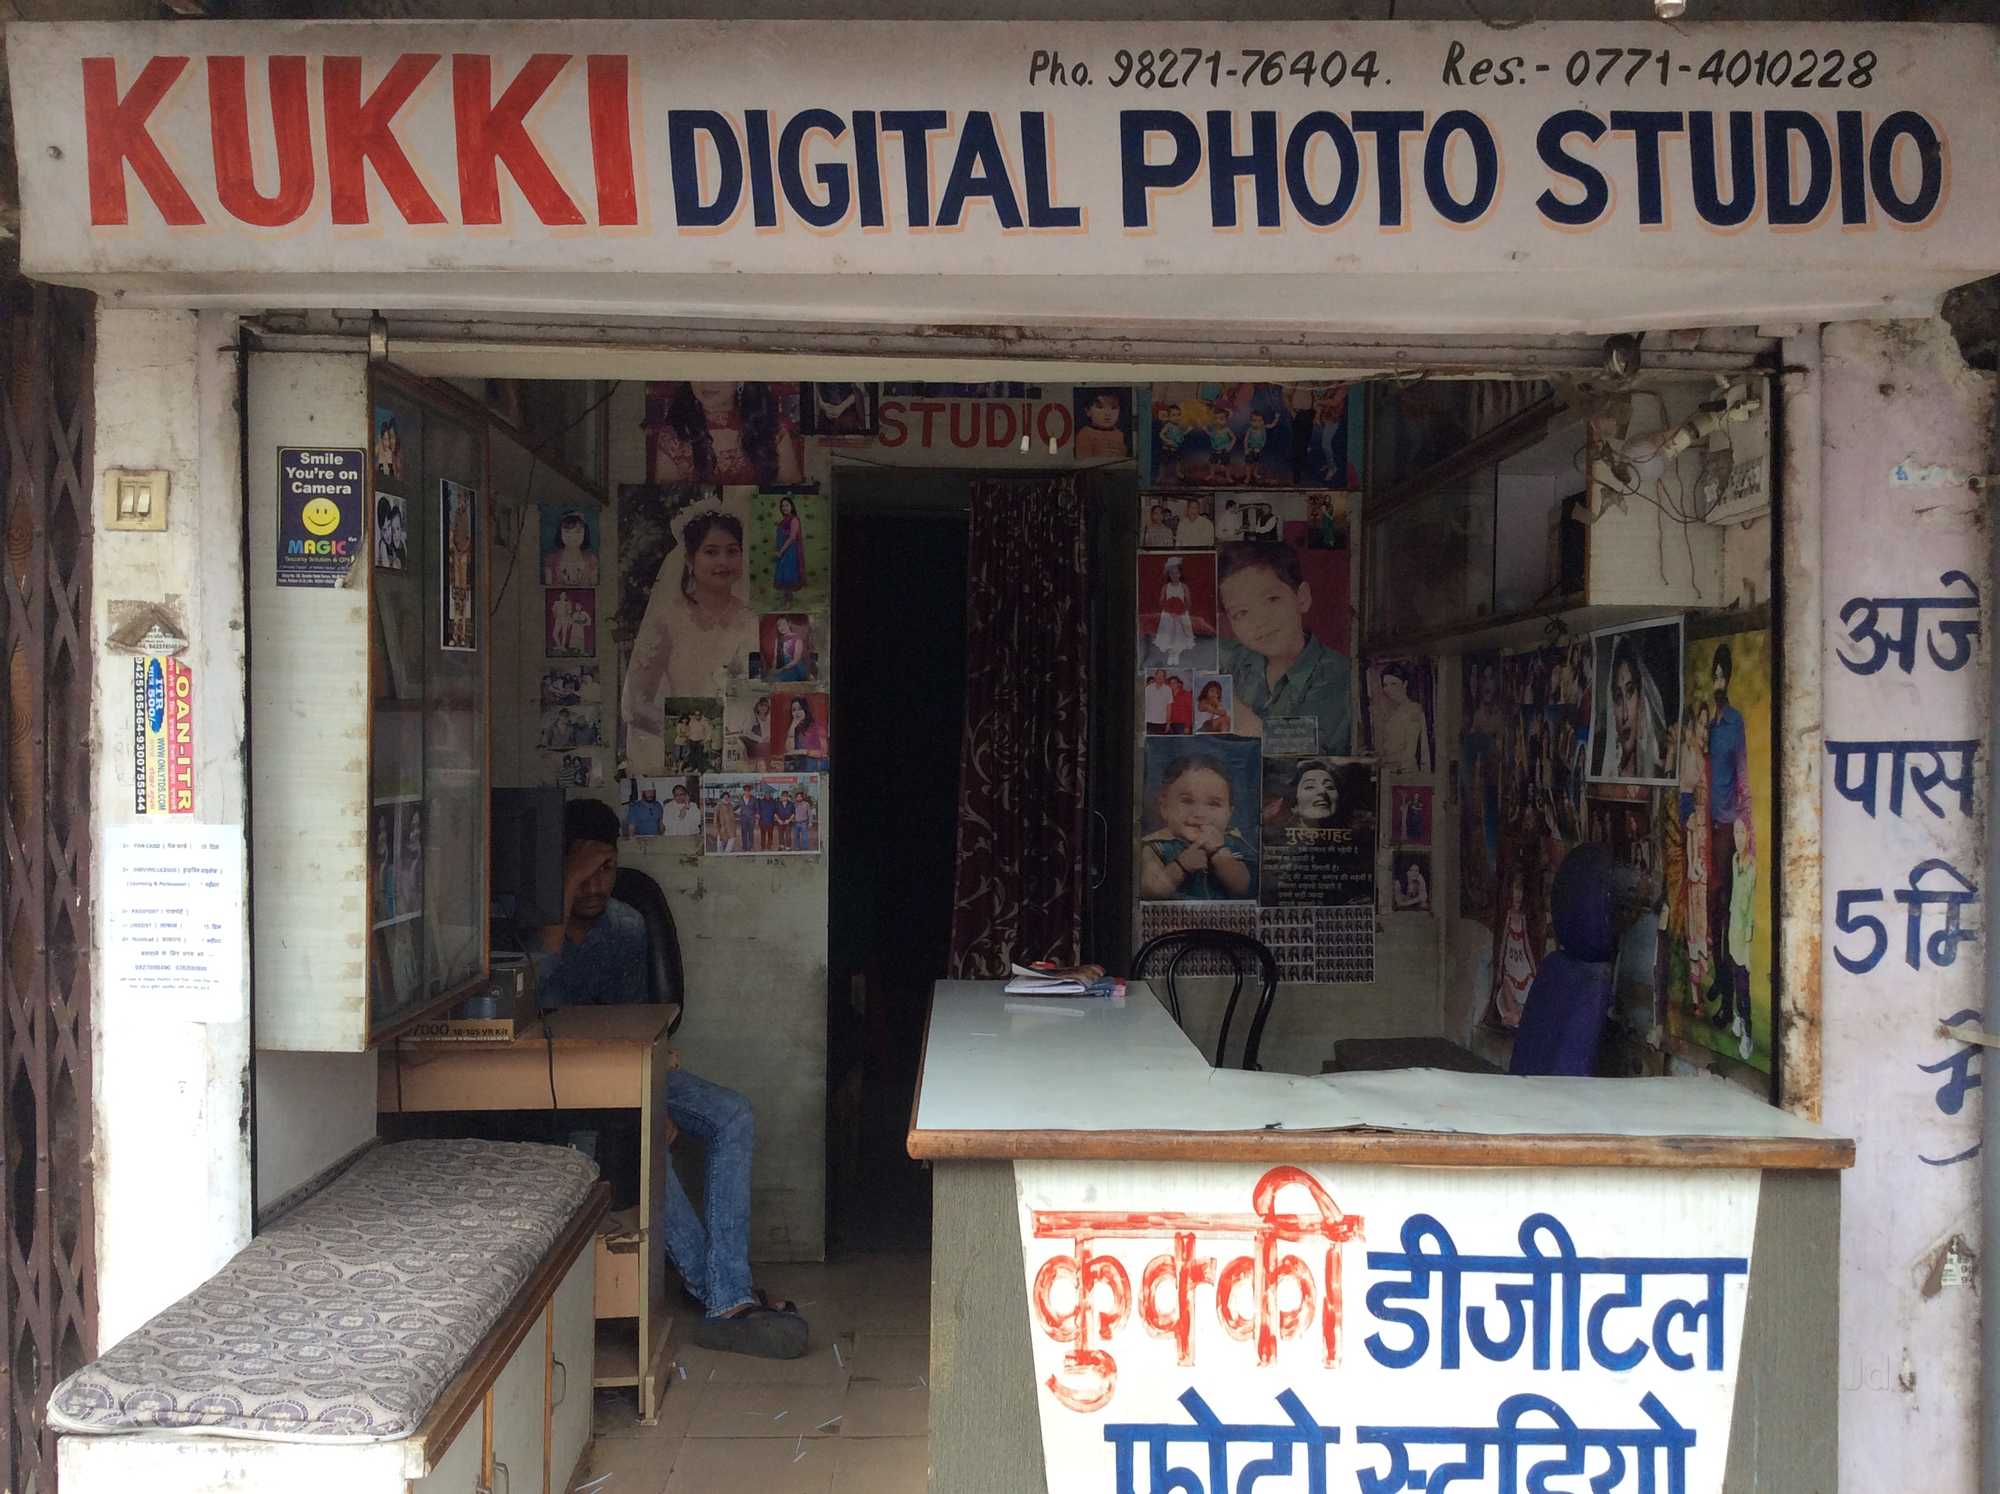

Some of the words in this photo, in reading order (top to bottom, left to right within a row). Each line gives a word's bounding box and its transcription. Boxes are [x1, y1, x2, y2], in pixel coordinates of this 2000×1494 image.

[1029, 49, 1093, 87] Pho.
[1565, 48, 1878, 89] 0771-4010228
[82, 53, 640, 227] KUKKI
[668, 108, 1082, 228] DIGITAL
[1120, 109, 1498, 228] PHOTO
[1536, 109, 1943, 226] STUDIO
[878, 400, 1074, 450] STUDIO
[286, 467, 336, 481] You're
[338, 469, 358, 480] on
[300, 452, 344, 466] Smile
[291, 482, 352, 495] Camera
[288, 539, 347, 555] MAGIC
[155, 678, 164, 710] ITR
[1364, 1212, 1749, 1372] डीजीटल
